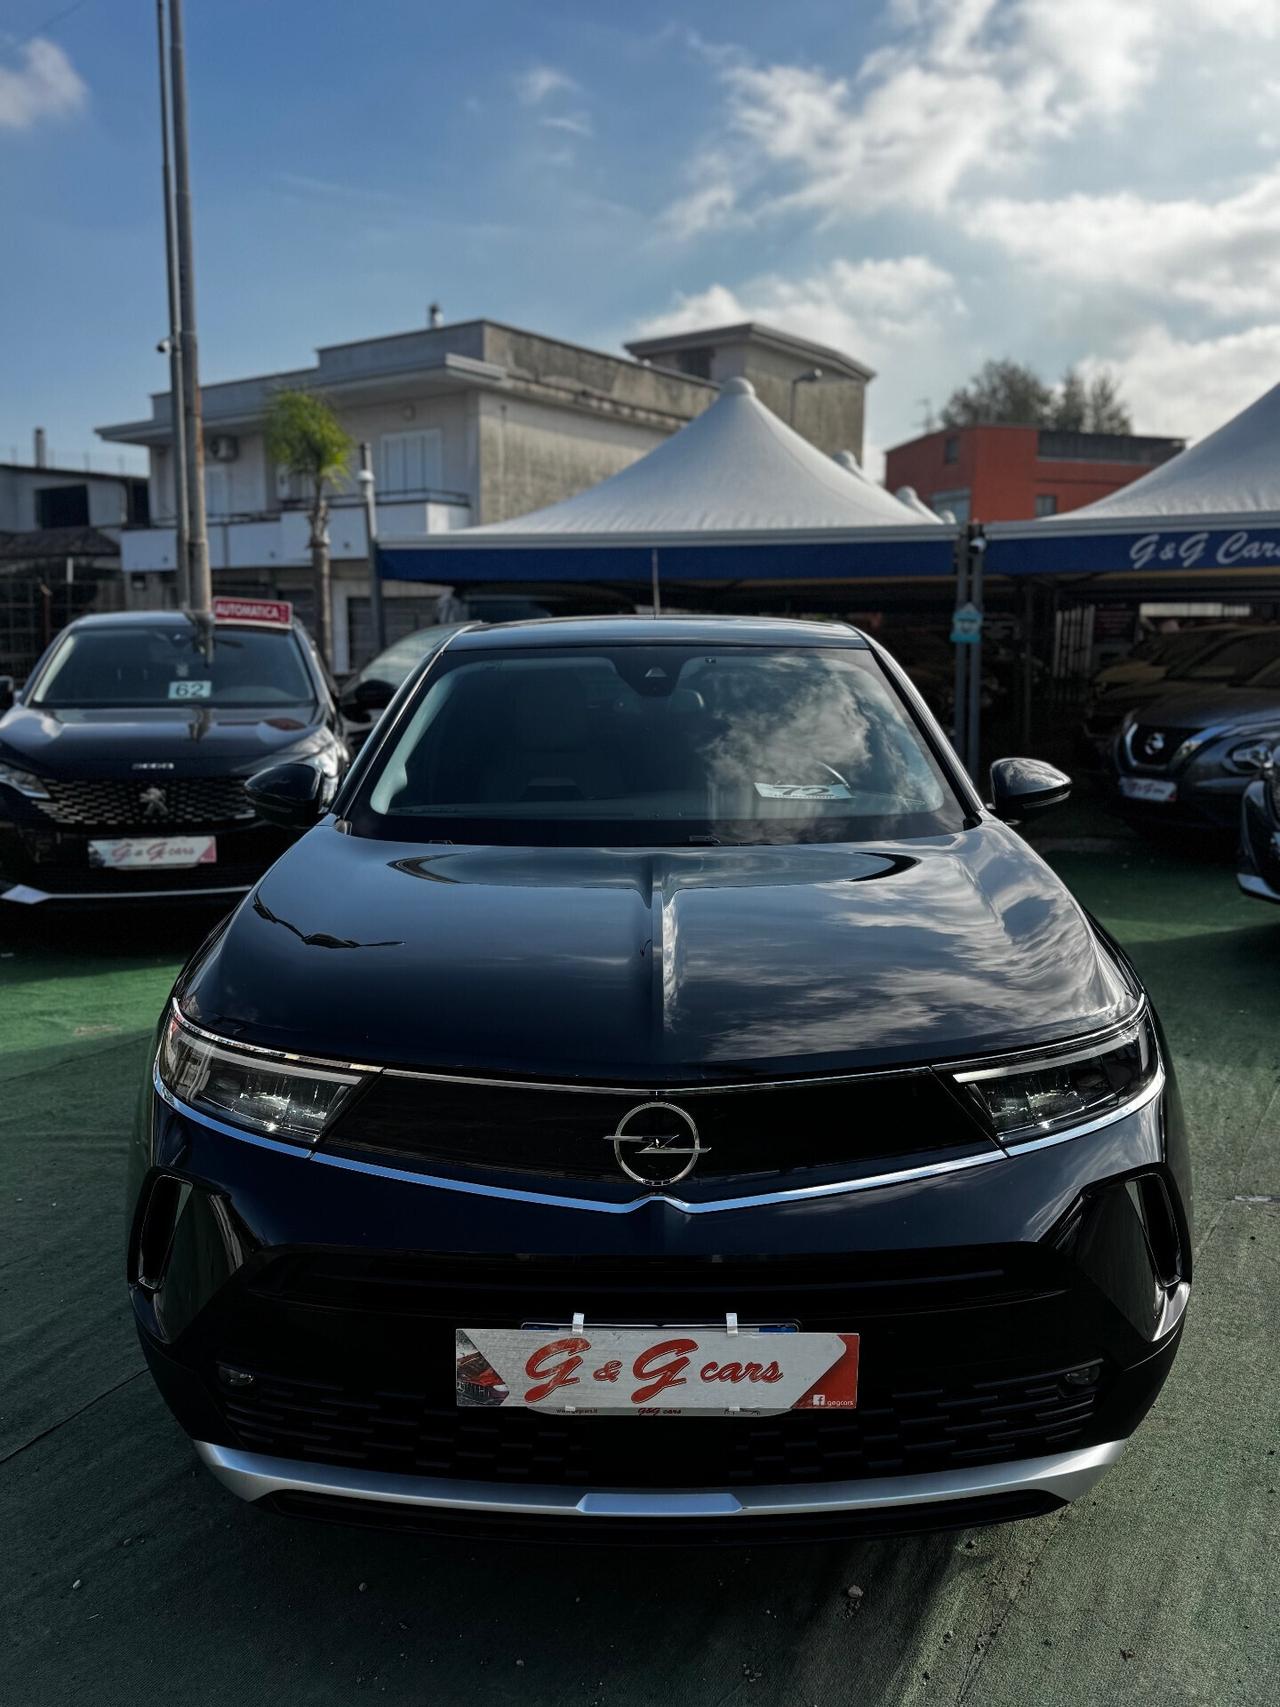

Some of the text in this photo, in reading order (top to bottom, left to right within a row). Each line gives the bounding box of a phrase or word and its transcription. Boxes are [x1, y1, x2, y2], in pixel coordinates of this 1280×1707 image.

[216, 603, 280, 619] AUTOMATICA
[176, 683, 204, 697] 62
[773, 786, 834, 796] 72
[700, 1359, 783, 1384] cars
